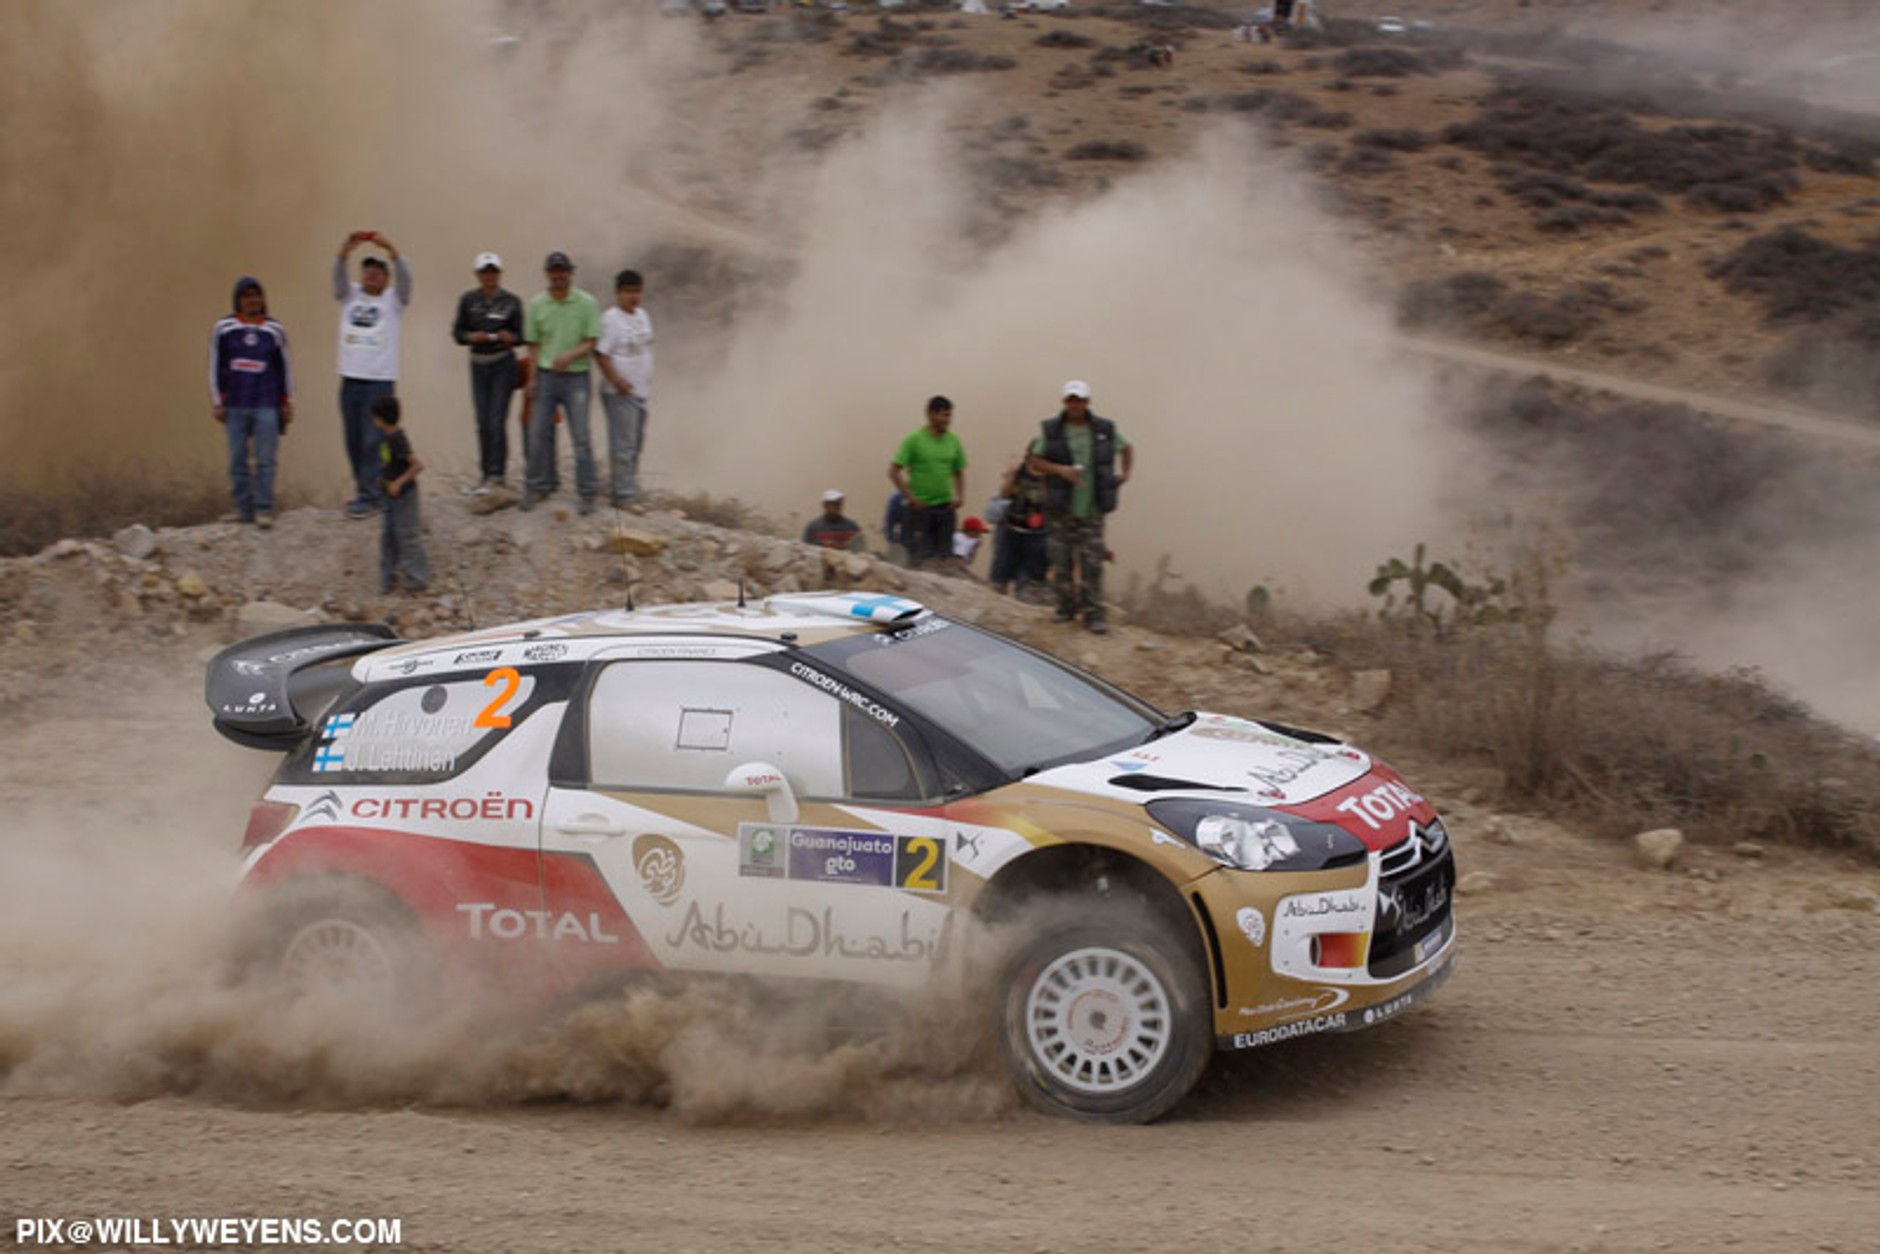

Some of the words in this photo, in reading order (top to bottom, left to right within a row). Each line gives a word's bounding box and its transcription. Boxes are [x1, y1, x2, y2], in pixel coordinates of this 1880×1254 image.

[472, 666, 521, 729] 2
[745, 774, 782, 786] TOTAL
[791, 832, 892, 855] Guanajuato
[825, 854, 856, 875] gto
[904, 836, 941, 890] 2
[455, 902, 620, 944] TOTAL
[1234, 1013, 1346, 1049] EURODATACAR
